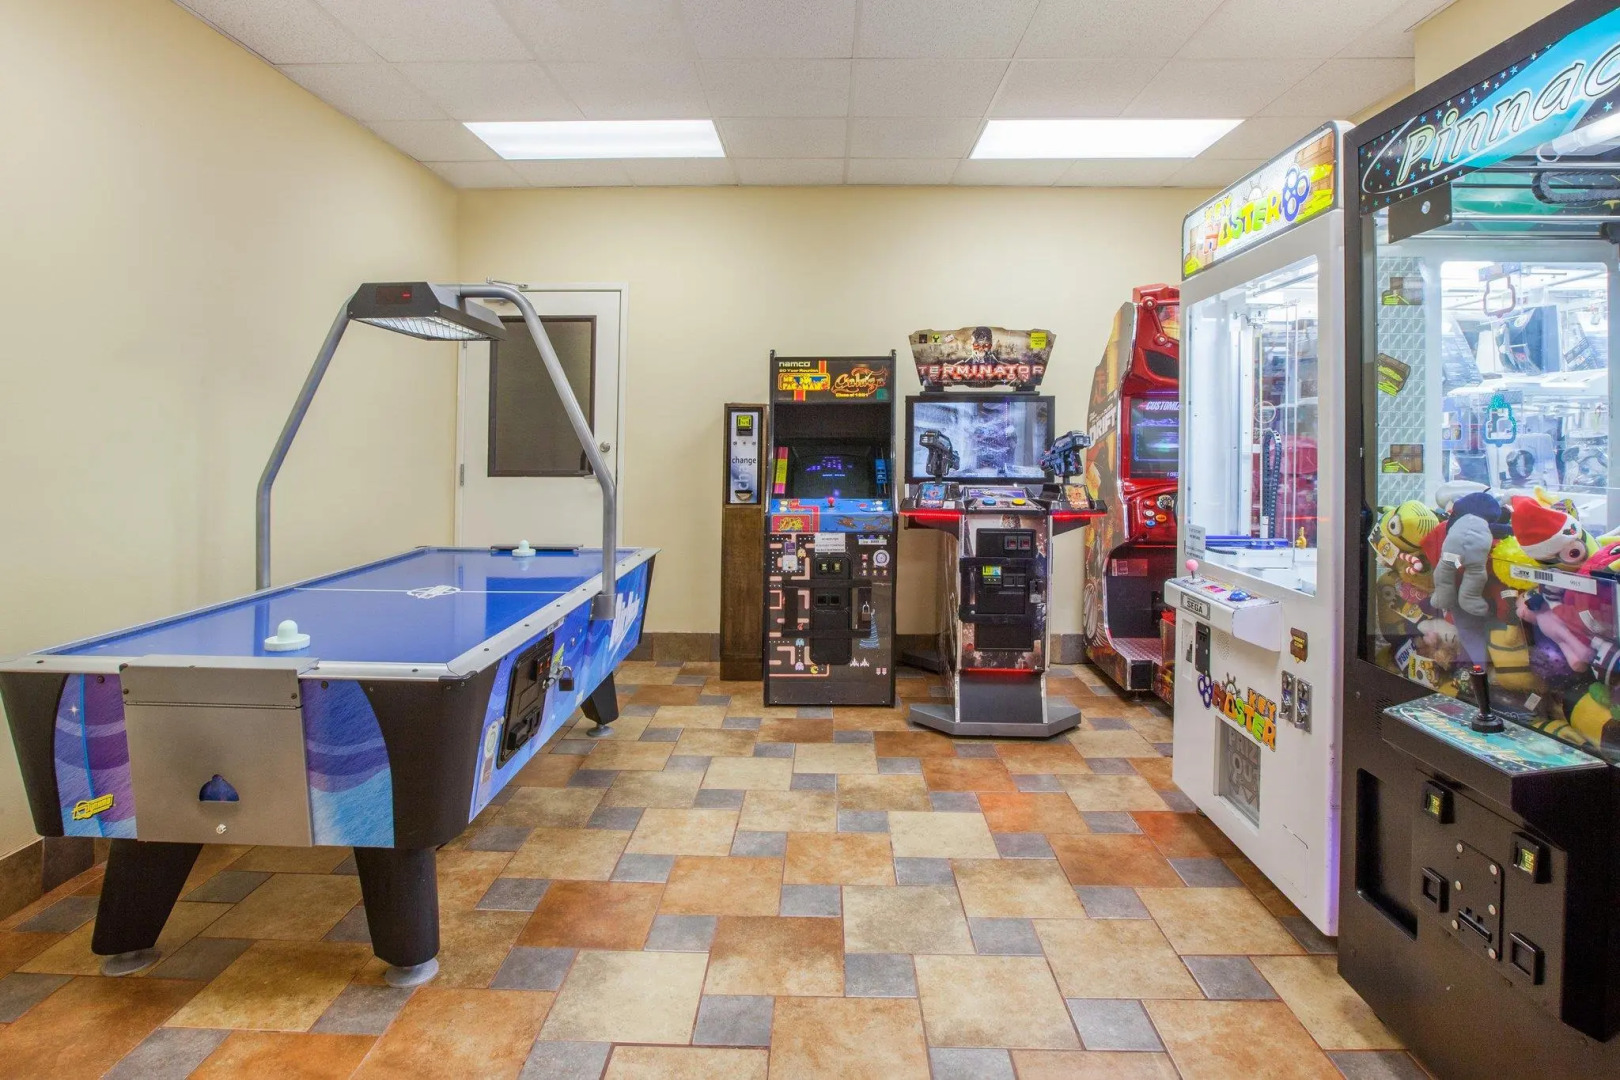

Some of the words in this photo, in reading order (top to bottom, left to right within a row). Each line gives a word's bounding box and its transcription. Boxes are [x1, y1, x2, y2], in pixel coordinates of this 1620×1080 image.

[1204, 191, 1282, 254] MASTER
[918, 365, 1044, 375] TERMINATOR
[1089, 405, 1117, 448] DRIFT
[731, 456, 757, 466] change
[1186, 600, 1203, 614] SEGA
[1212, 681, 1276, 752] MASTER
[1248, 687, 1277, 721] KEY
